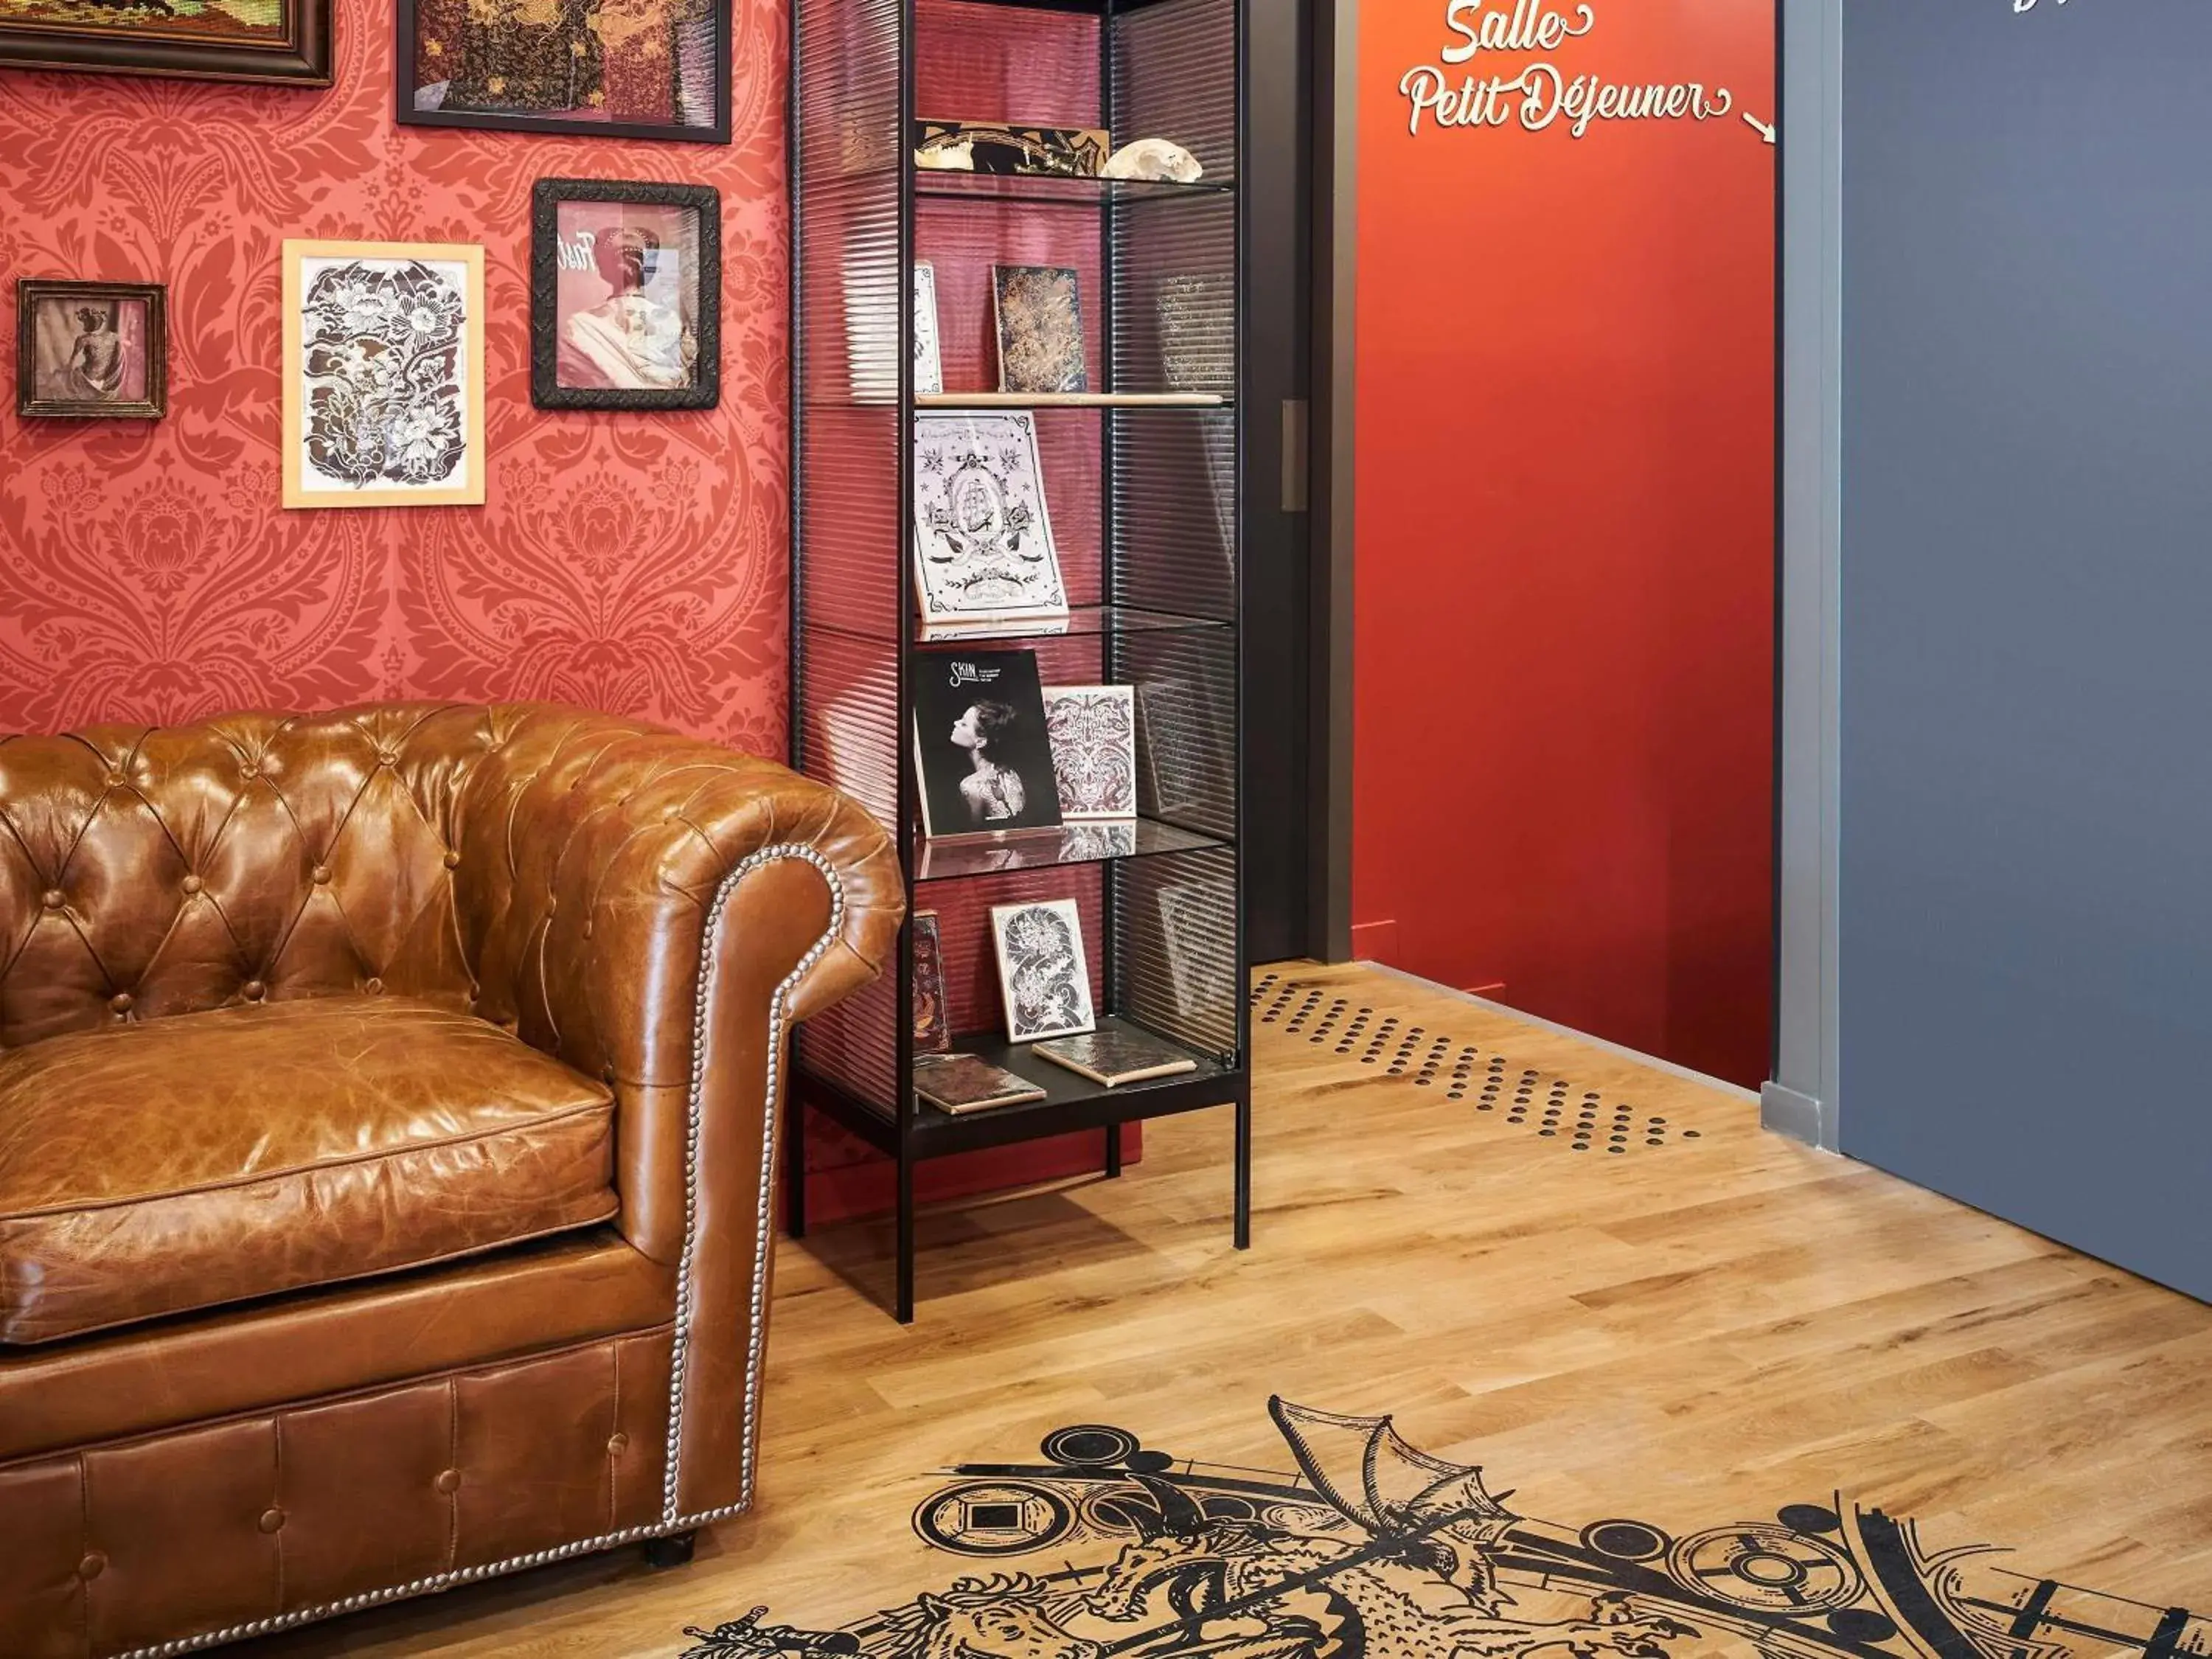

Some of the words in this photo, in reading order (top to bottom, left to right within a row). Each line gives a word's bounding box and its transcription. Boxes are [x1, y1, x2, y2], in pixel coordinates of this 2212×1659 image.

[1441, 0, 1594, 63] Salle
[1399, 65, 1520, 136] Petit
[1520, 63, 1732, 138] Déjeuner
